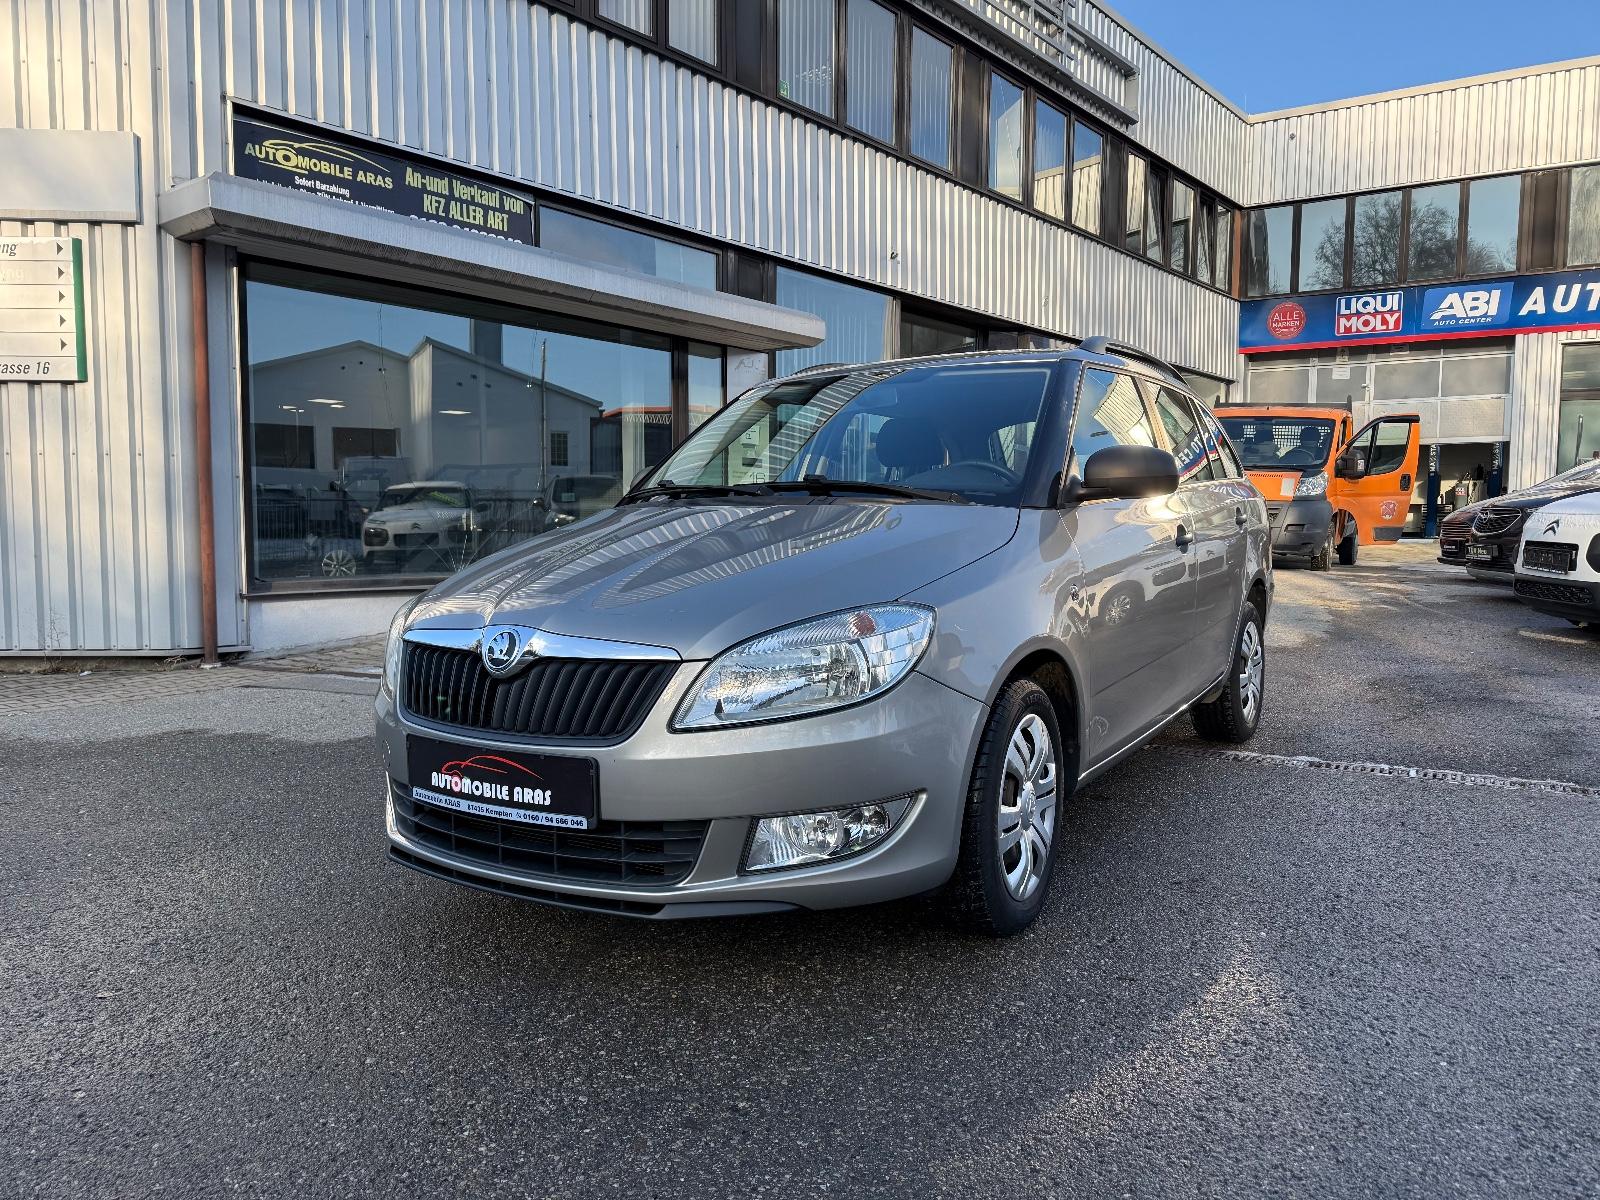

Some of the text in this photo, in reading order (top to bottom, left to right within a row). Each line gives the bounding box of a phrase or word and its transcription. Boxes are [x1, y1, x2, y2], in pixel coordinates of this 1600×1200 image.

[244, 142, 394, 189] AUTOMOBILE ARAS
[294, 175, 315, 188] Sofort
[315, 179, 350, 198] Barzahlung
[405, 166, 524, 215] An-und Verkauf von
[423, 193, 446, 217] KFZ
[449, 200, 484, 226] ALLER
[487, 209, 509, 231] ART
[0, 243, 17, 257] ng
[1340, 293, 1400, 315] LIQUI
[1430, 289, 1502, 320] ABI
[1272, 310, 1300, 321] ALLE
[1272, 320, 1300, 328] MARKEN
[1340, 312, 1400, 333] MOLY
[1434, 317, 1493, 326] AUTO CENTER
[0, 361, 51, 375] asse 16
[431, 771, 552, 806] AUTOMOBILE ARAS
[443, 797, 461, 808] ARAS
[485, 807, 513, 818] Kempten
[523, 813, 540, 822] 0160
[544, 816, 554, 824] 94
[570, 819, 584, 827] 046
